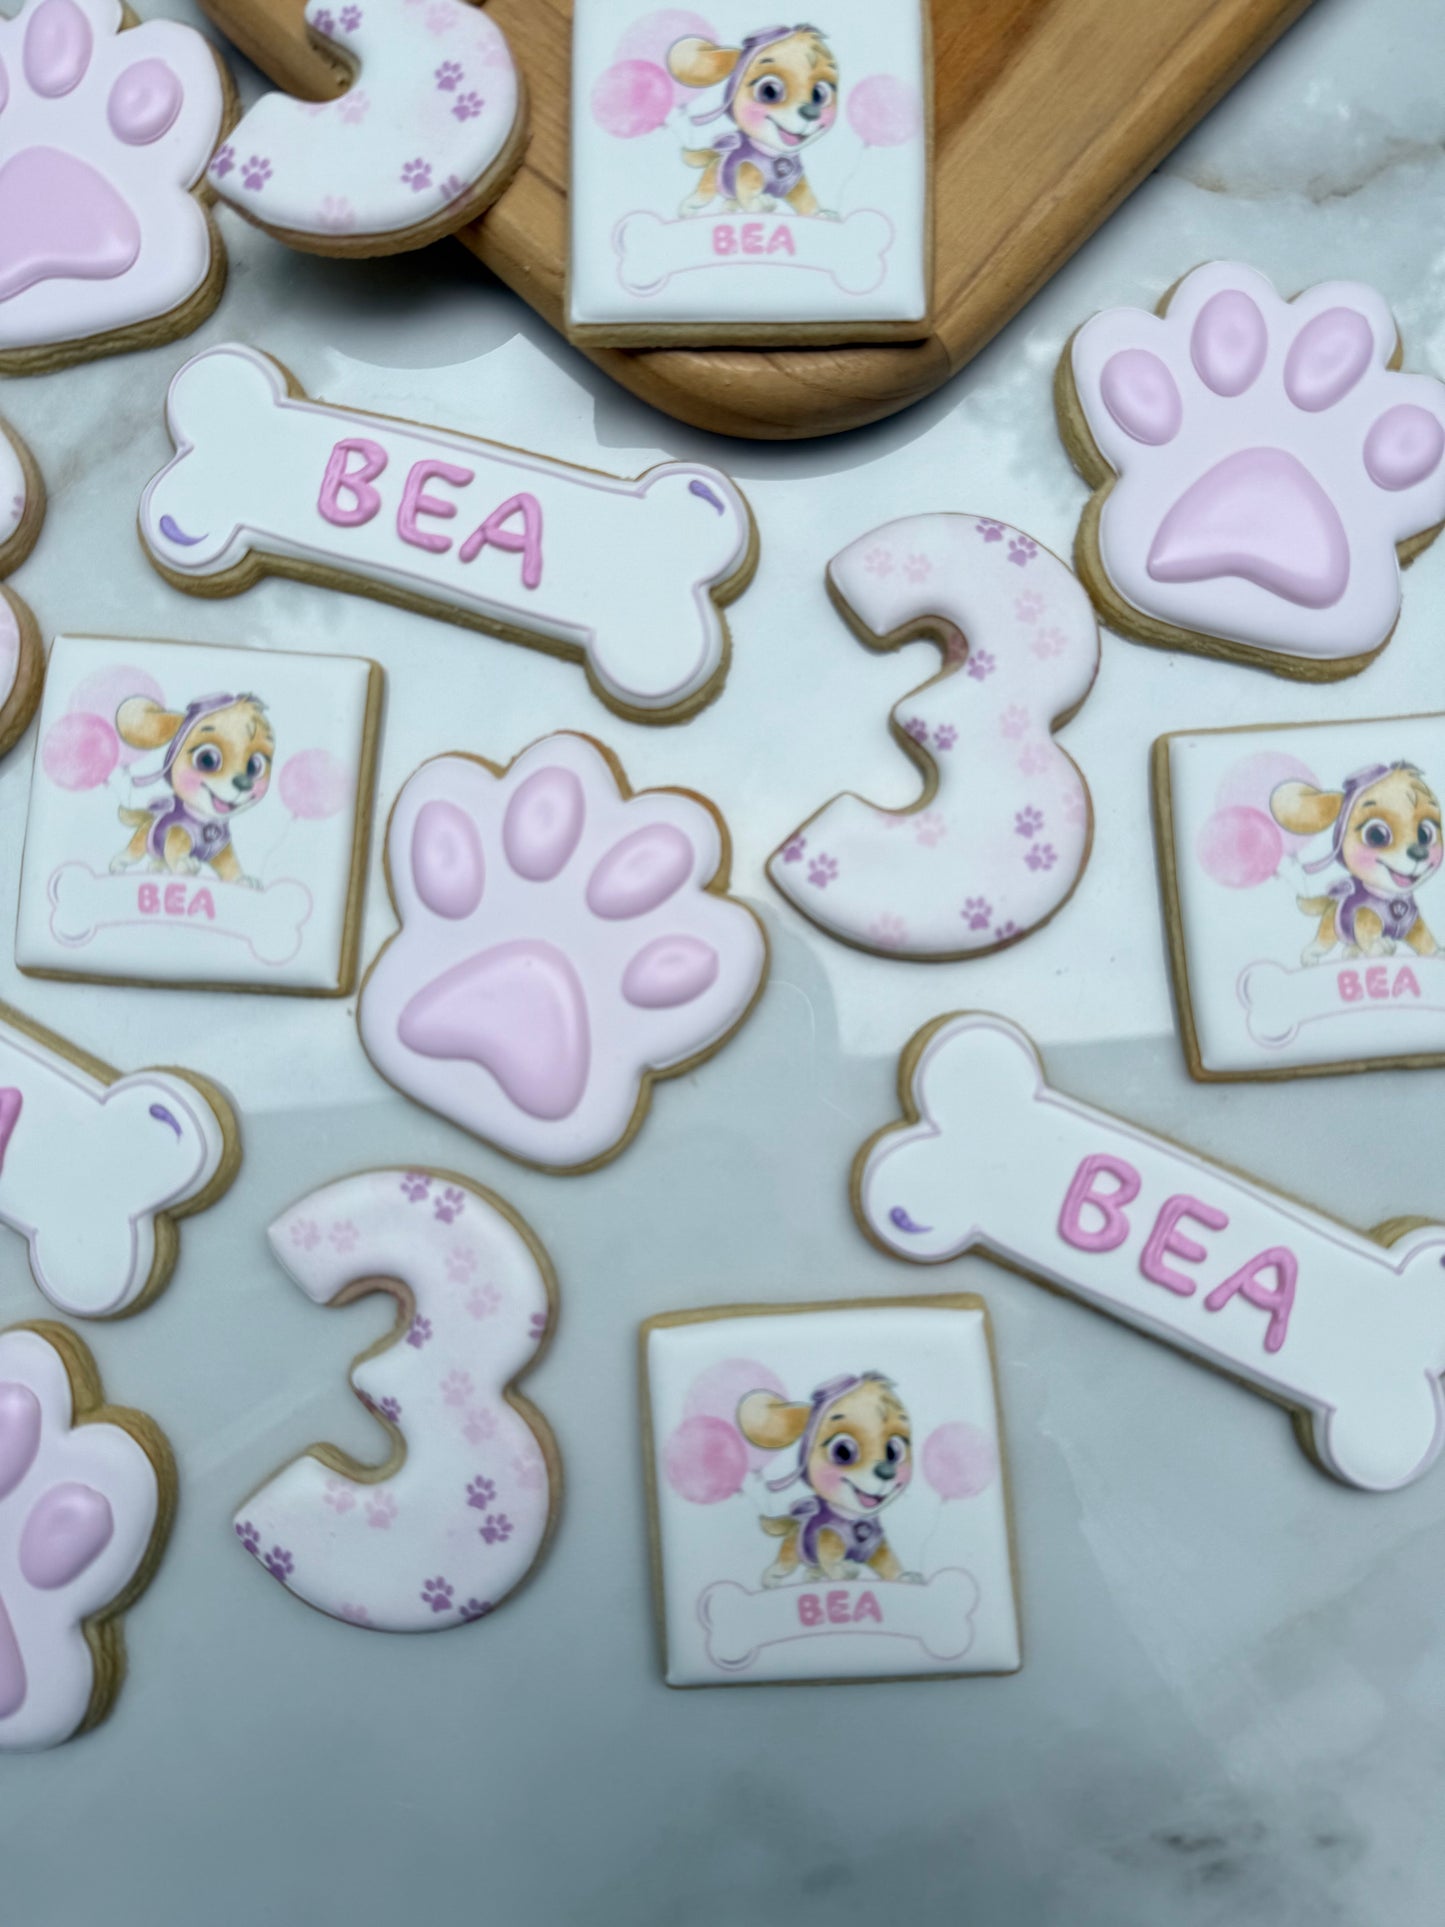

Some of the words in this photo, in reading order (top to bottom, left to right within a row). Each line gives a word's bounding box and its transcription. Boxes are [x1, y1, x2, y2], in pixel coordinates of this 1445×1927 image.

[712, 222, 796, 255] BEA
[317, 438, 543, 589] BEA
[137, 883, 215, 919] BEA
[1337, 966, 1420, 1002] BEA
[1058, 1153, 1298, 1353] BEA
[798, 1591, 882, 1626] BEA
